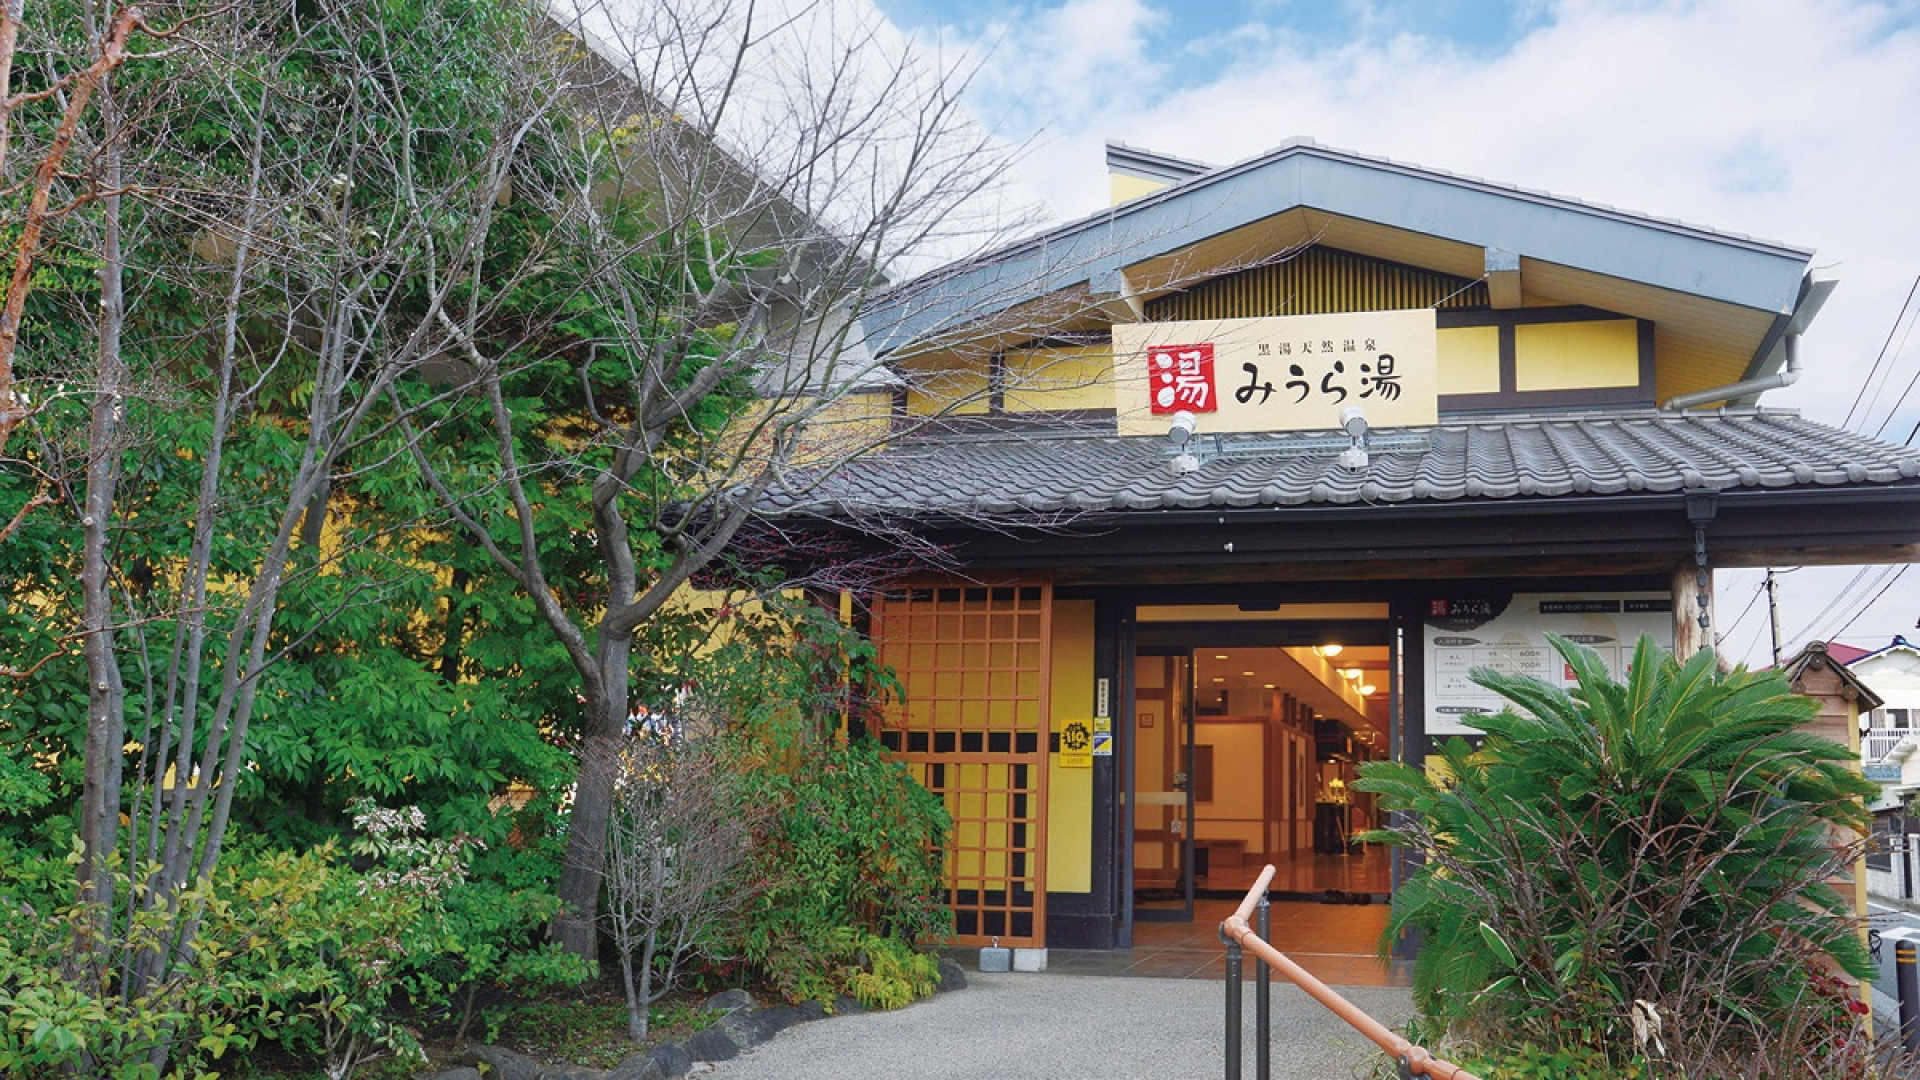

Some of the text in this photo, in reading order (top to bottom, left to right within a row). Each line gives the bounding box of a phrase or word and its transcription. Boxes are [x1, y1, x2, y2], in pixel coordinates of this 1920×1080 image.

[1258, 338, 1377, 356] 黒湯天然温泉
[1155, 351, 1209, 408] 湯
[1235, 353, 1402, 406] みうら湯
